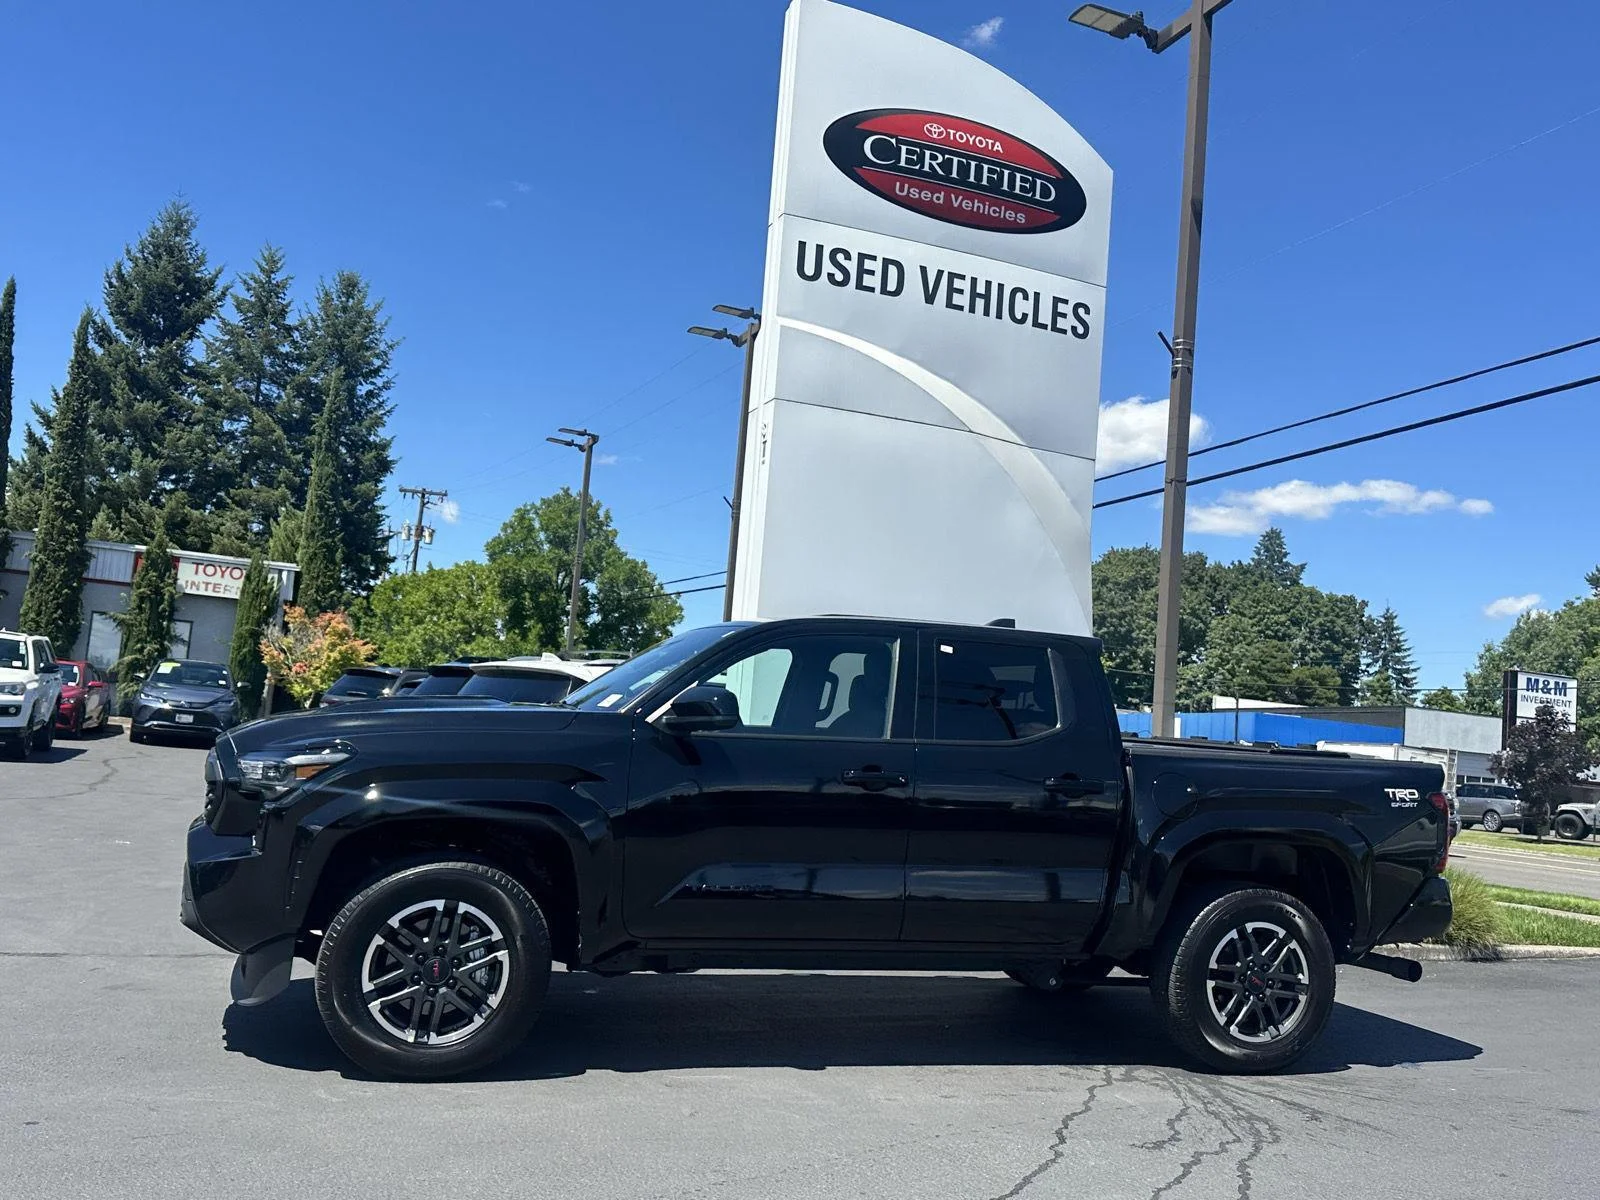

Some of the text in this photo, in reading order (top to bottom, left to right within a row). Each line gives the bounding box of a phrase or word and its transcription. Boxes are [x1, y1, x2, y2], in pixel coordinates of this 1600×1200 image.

[947, 129, 1004, 154] TOYOTA
[863, 135, 1056, 203] CERTIFIED
[895, 181, 1026, 224] Used Vehicles
[796, 240, 1091, 341] USED VEHICLES
[191, 561, 247, 580] TOYO
[1526, 676, 1568, 697] M&M
[1520, 694, 1573, 709] INVESTMENT
[1384, 788, 1419, 801] TRD
